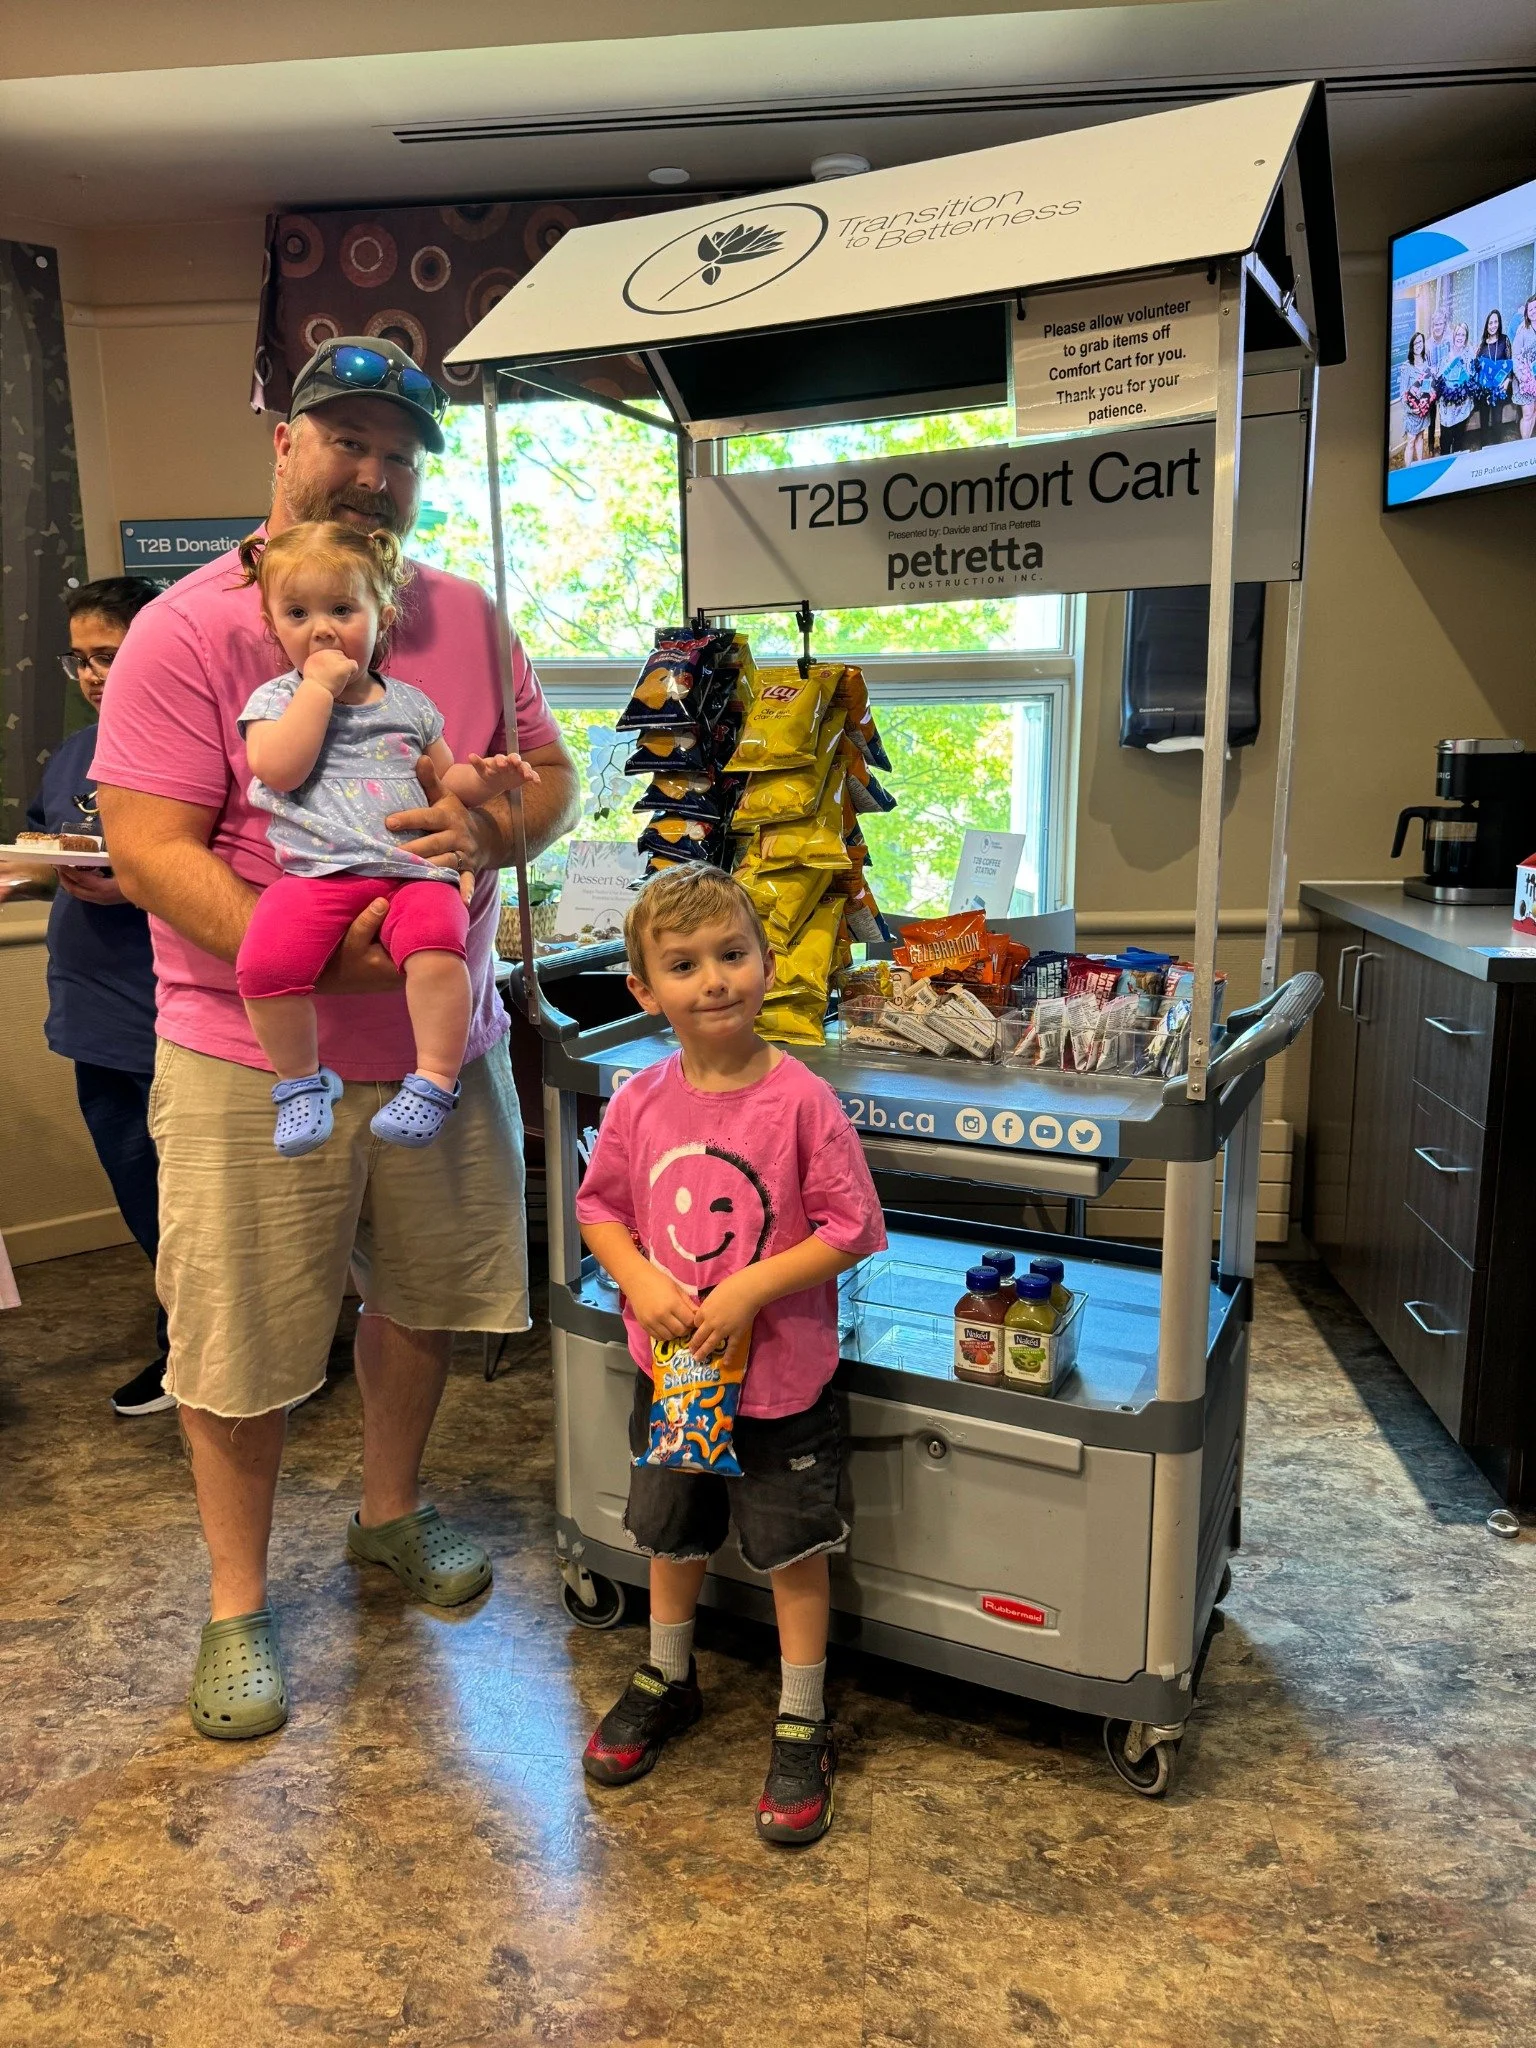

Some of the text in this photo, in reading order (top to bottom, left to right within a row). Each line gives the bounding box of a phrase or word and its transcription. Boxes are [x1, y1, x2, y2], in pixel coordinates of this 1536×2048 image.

[838, 190, 1024, 238] Transition
[845, 200, 1082, 250] to Betterness
[1043, 300, 1191, 339] Please allow volunteer
[1063, 324, 1171, 357] to grab items off
[1049, 348, 1186, 381] Comfort Cart for you.
[1056, 373, 1180, 405] Thank you for your
[1088, 402, 1147, 424] patience.
[778, 448, 1201, 531] T2B Comfort Cart
[136, 536, 244, 553] T2B Donatio
[888, 519, 1041, 540] Presented by: Davide and Tina Petretta
[887, 537, 1043, 590] petretta
[900, 573, 1043, 590] CONSTRUCTION INC.
[572, 873, 614, 886] Dessert
[909, 931, 980, 965] CELEBRATION
[984, 1599, 1042, 1623] Rubbermaid
